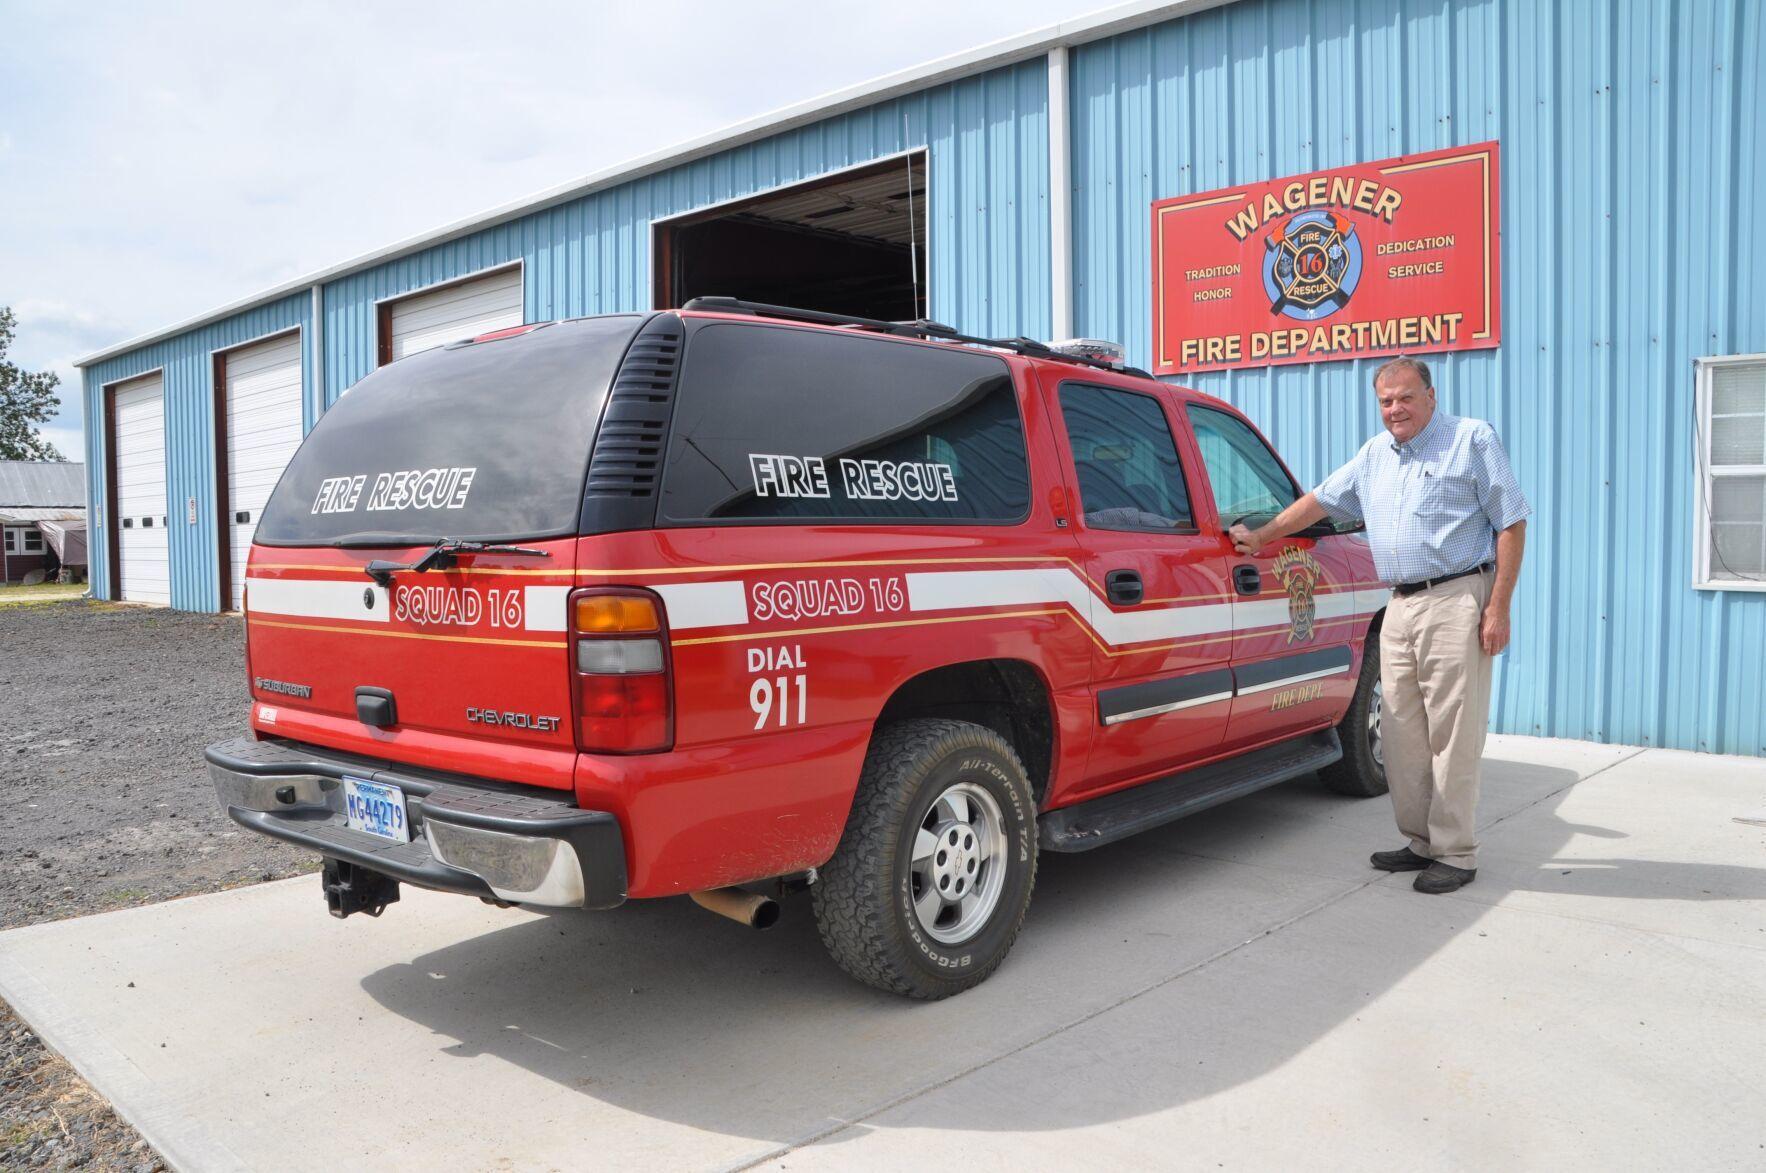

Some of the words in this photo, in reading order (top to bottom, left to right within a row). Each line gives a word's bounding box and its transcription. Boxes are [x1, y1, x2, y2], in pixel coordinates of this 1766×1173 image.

[1226, 177, 1402, 241] WAGENER
[1301, 232, 1320, 243] FIRE
[1377, 235, 1455, 255] DEDICATION
[1185, 264, 1241, 280] TRADITION
[1300, 253, 1323, 275] 16
[1388, 262, 1444, 278] SERVICE
[1194, 288, 1232, 301] HONOR
[1293, 283, 1329, 296] RESCUE
[1181, 335, 1242, 364] FIRE
[1251, 313, 1463, 359] DEPARTMENT
[749, 454, 830, 498] FIRE
[840, 458, 958, 501] RESCUE
[311, 475, 367, 514] FIRE
[367, 467, 476, 511] RESCUE
[1272, 543, 1321, 581] WAGENER
[395, 585, 483, 626] SQUAD
[488, 589, 522, 628] 16
[753, 579, 864, 621] SQUAD
[869, 578, 904, 612] 16
[747, 645, 807, 672] DIAL
[262, 680, 312, 699] SUBURBAN
[749, 674, 807, 730] 911
[1271, 689, 1297, 711] FIRE
[466, 707, 560, 731] CHEVROLET
[347, 794, 403, 829] MG44279
